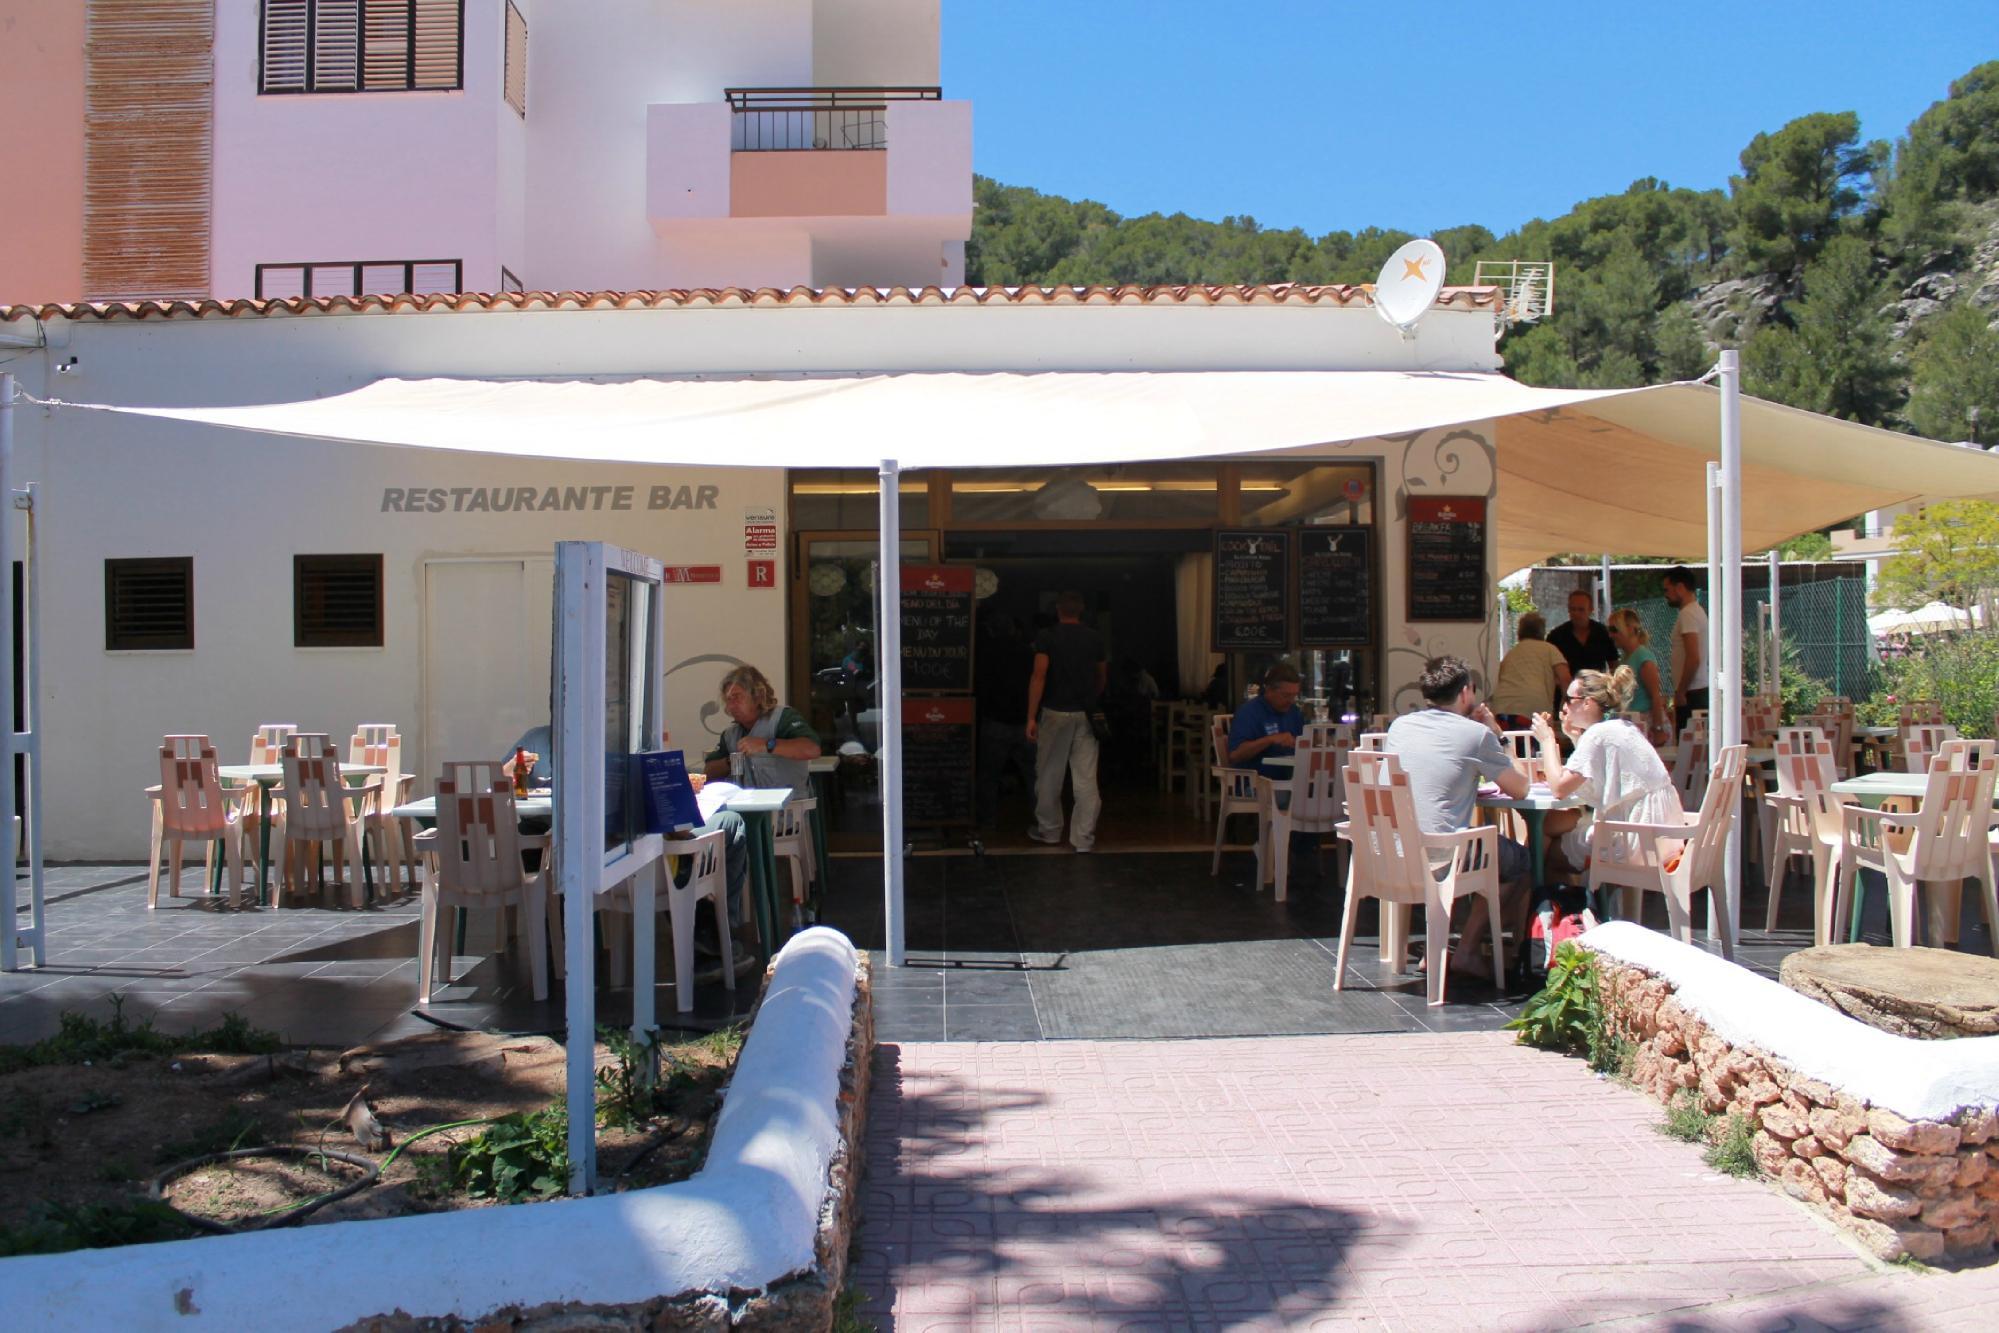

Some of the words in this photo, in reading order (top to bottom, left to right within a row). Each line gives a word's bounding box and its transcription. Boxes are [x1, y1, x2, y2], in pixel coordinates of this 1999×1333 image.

[381, 486, 635, 513] RESTAURANTE
[647, 485, 720, 511] BAR
[745, 526, 776, 534] Alarma
[756, 566, 768, 582] R
